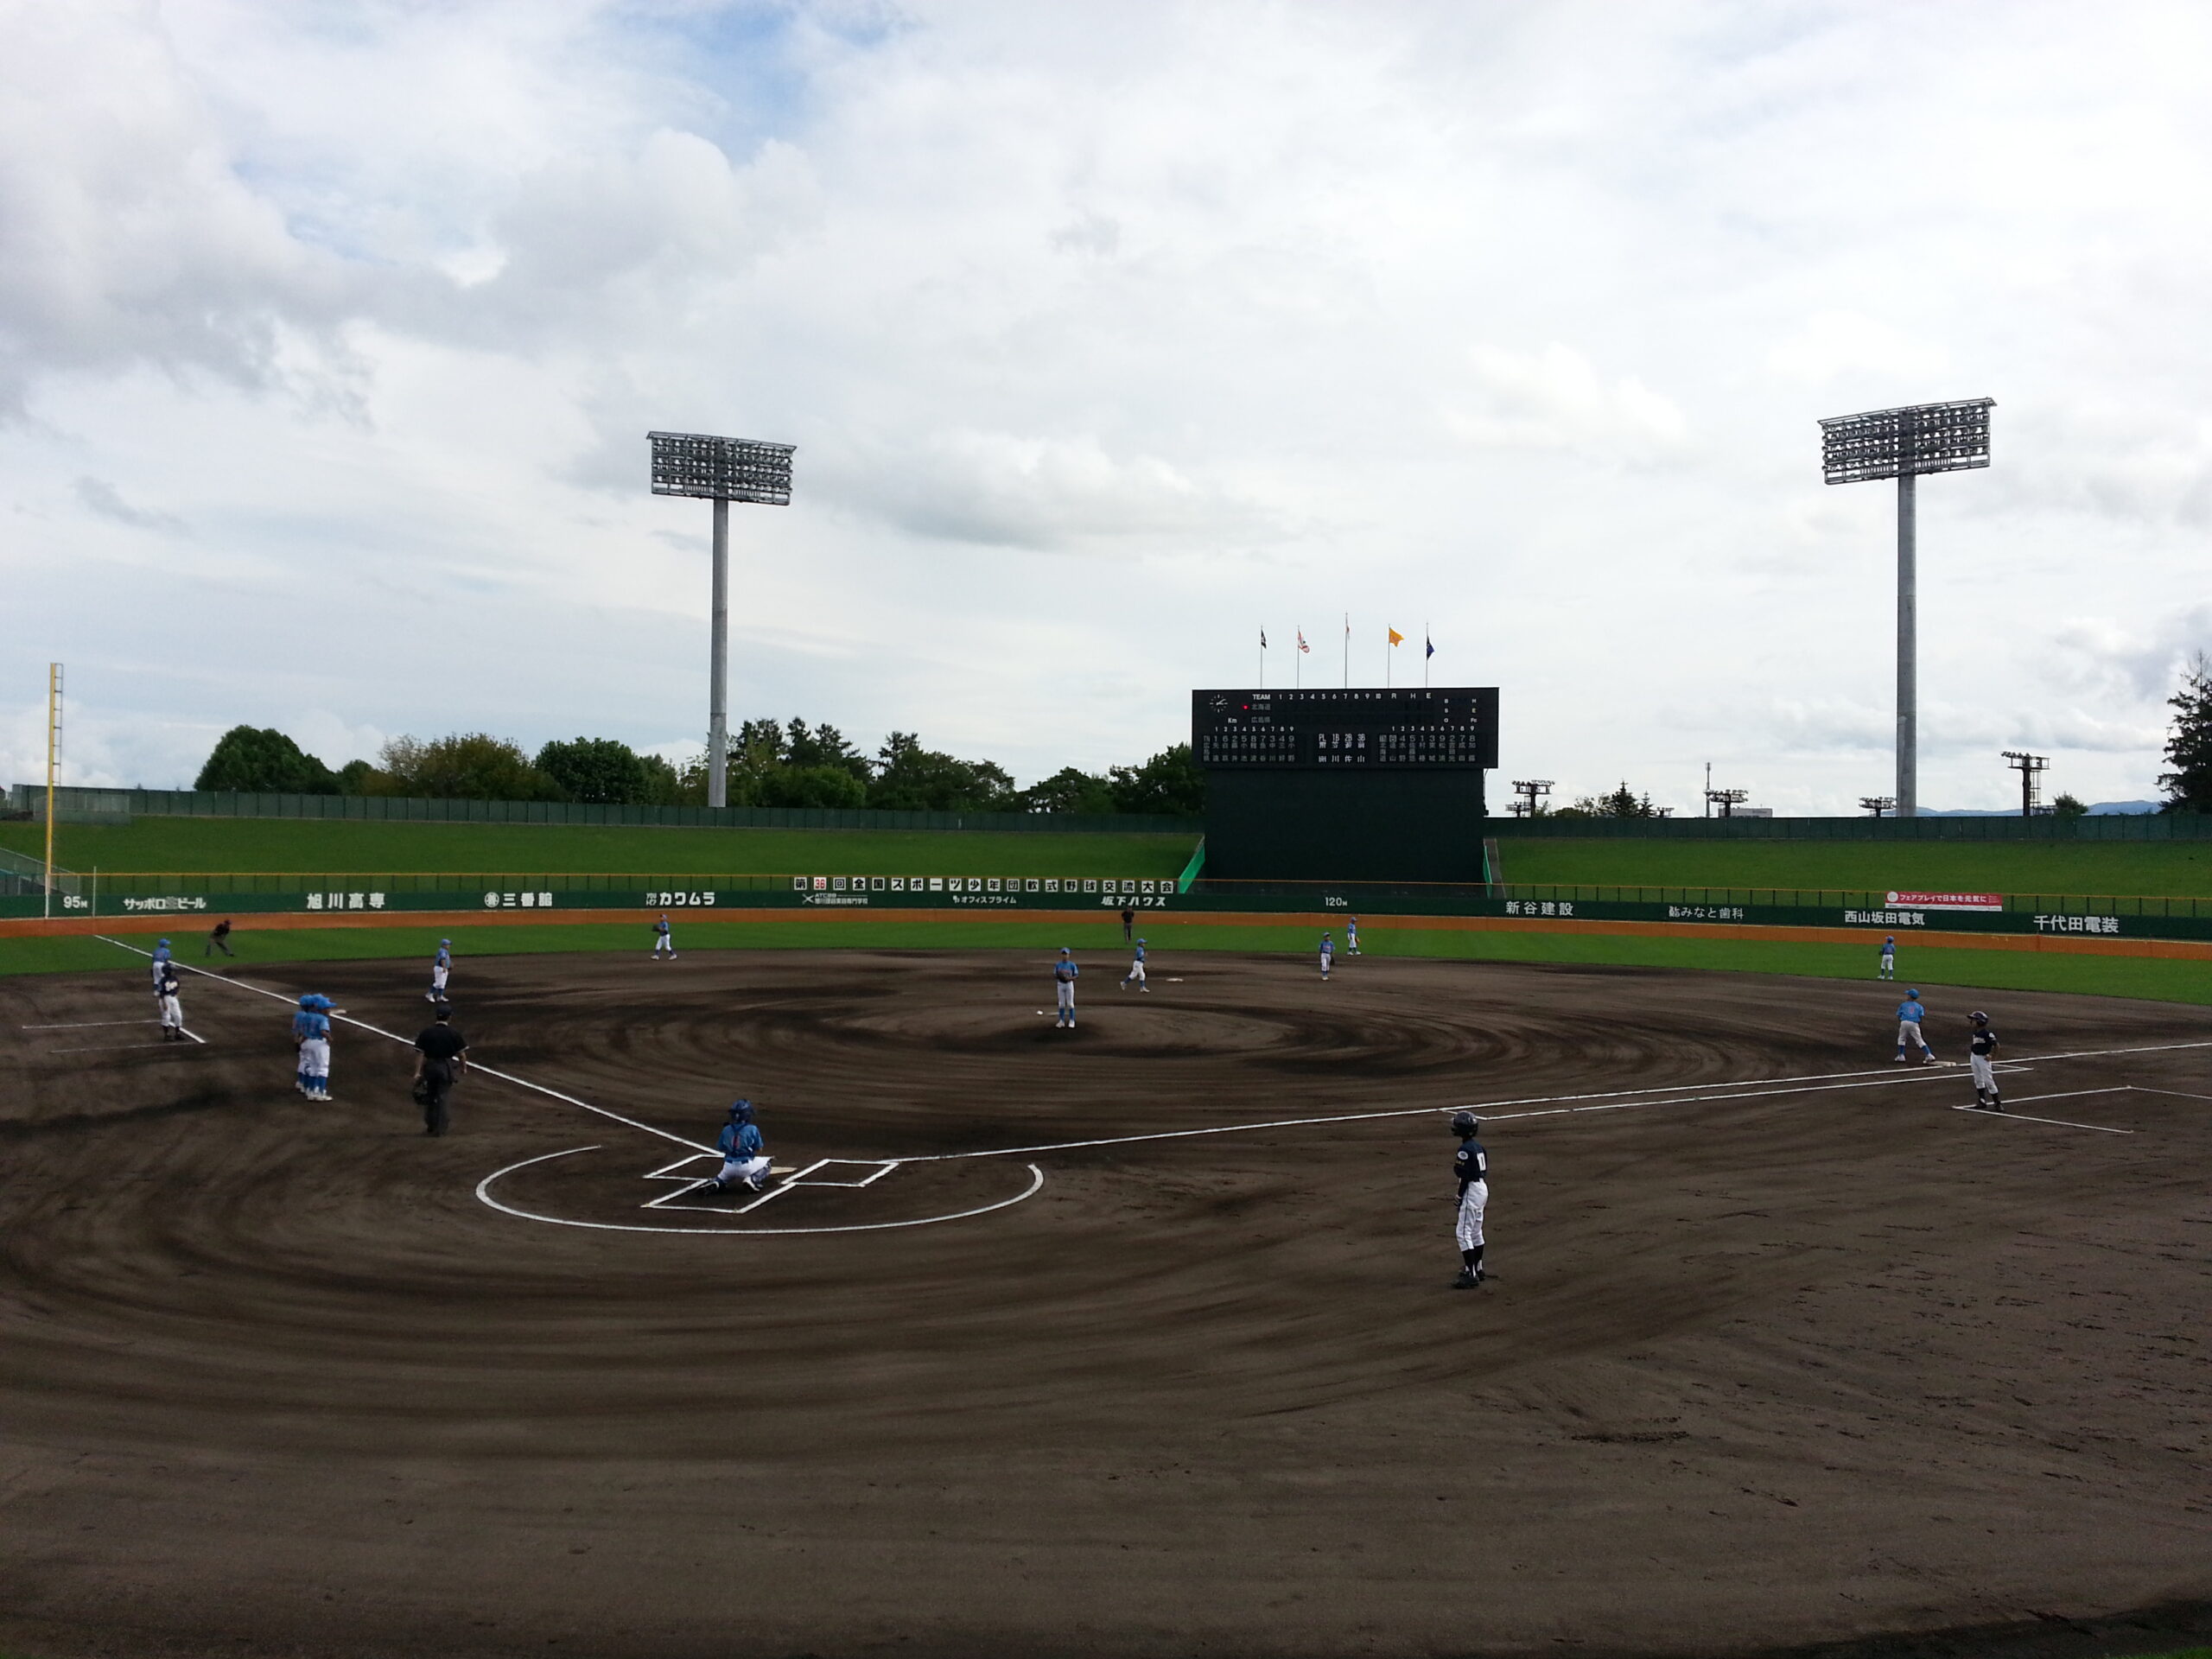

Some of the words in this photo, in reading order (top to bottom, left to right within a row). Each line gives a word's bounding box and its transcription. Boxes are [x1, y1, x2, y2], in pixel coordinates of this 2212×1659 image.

[307, 893, 385, 909] 旭川高専
[659, 892, 715, 906] カワムラ
[961, 895, 1016, 905] オフィスプライム
[1505, 901, 1573, 917] 新谷建設
[1844, 910, 1925, 925] 西山坂田電気
[2033, 914, 2120, 933] 千代田電装
